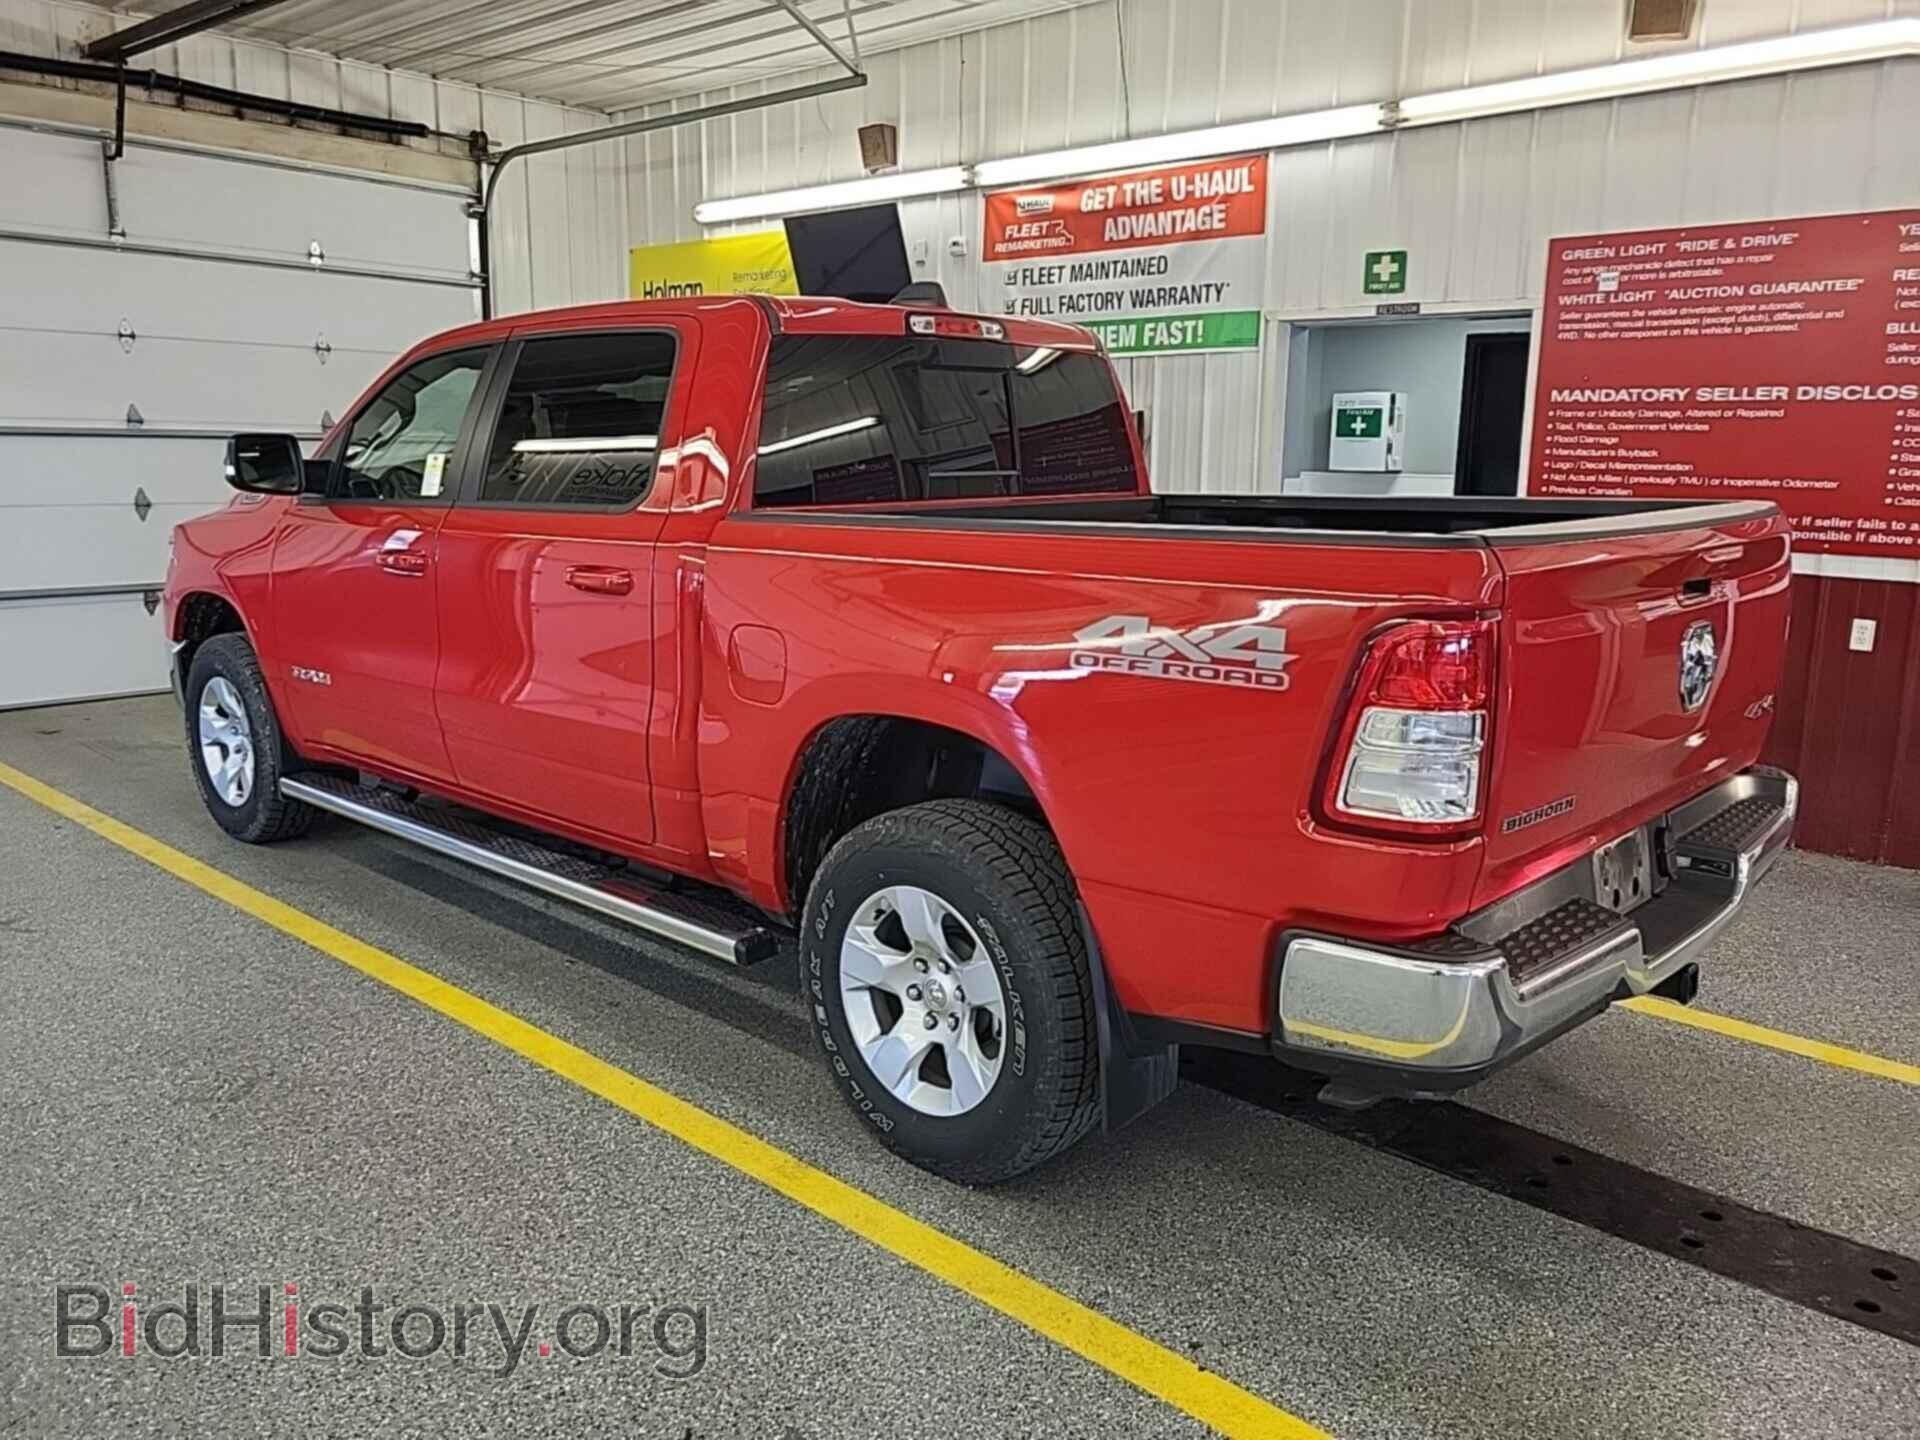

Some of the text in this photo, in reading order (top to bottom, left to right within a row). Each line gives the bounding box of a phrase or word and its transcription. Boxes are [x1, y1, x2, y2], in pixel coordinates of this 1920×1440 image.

[1080, 167, 1255, 213] GET THE U-HAUL
[1005, 221, 1050, 240] FLEET
[1104, 204, 1227, 242] ADVANTAGE
[994, 237, 1067, 253] REMARKETING
[1561, 233, 1799, 261] GREEN LIGHT "RIDE & DRIVE"
[1022, 255, 1168, 286] FLEET MAINTAINED
[643, 279, 704, 298] Holman
[1558, 278, 1865, 306] WHITE LIGHT "AUCTION GUARANTEE"
[1020, 297, 1055, 316] FULL
[1058, 291, 1124, 313] FACTORY
[1090, 320, 1204, 348] HEM FAST!
[1551, 388, 1690, 402] MANDATORY
[1695, 386, 1789, 401] SELLER
[1556, 409, 1586, 418] Frame
[1587, 410, 1597, 418] or
[1598, 409, 1637, 419] Unibody
[1684, 408, 1722, 418] Altered
[1723, 409, 1735, 418] or
[1736, 408, 1785, 418] Repaired
[1607, 422, 1667, 431] Government
[1668, 423, 1710, 431] Vehicles
[1579, 435, 1620, 445] Damage
[1617, 448, 1659, 458] Buyback
[1782, 478, 1840, 489] Odometer
[1802, 515, 1813, 526] if
[1814, 517, 1853, 529] seller
[1857, 518, 1888, 530] fails
[1891, 520, 1906, 531] to
[1855, 532, 1867, 543] if
[1869, 532, 1914, 544] above
[1073, 653, 1286, 688] OFF ROAD
